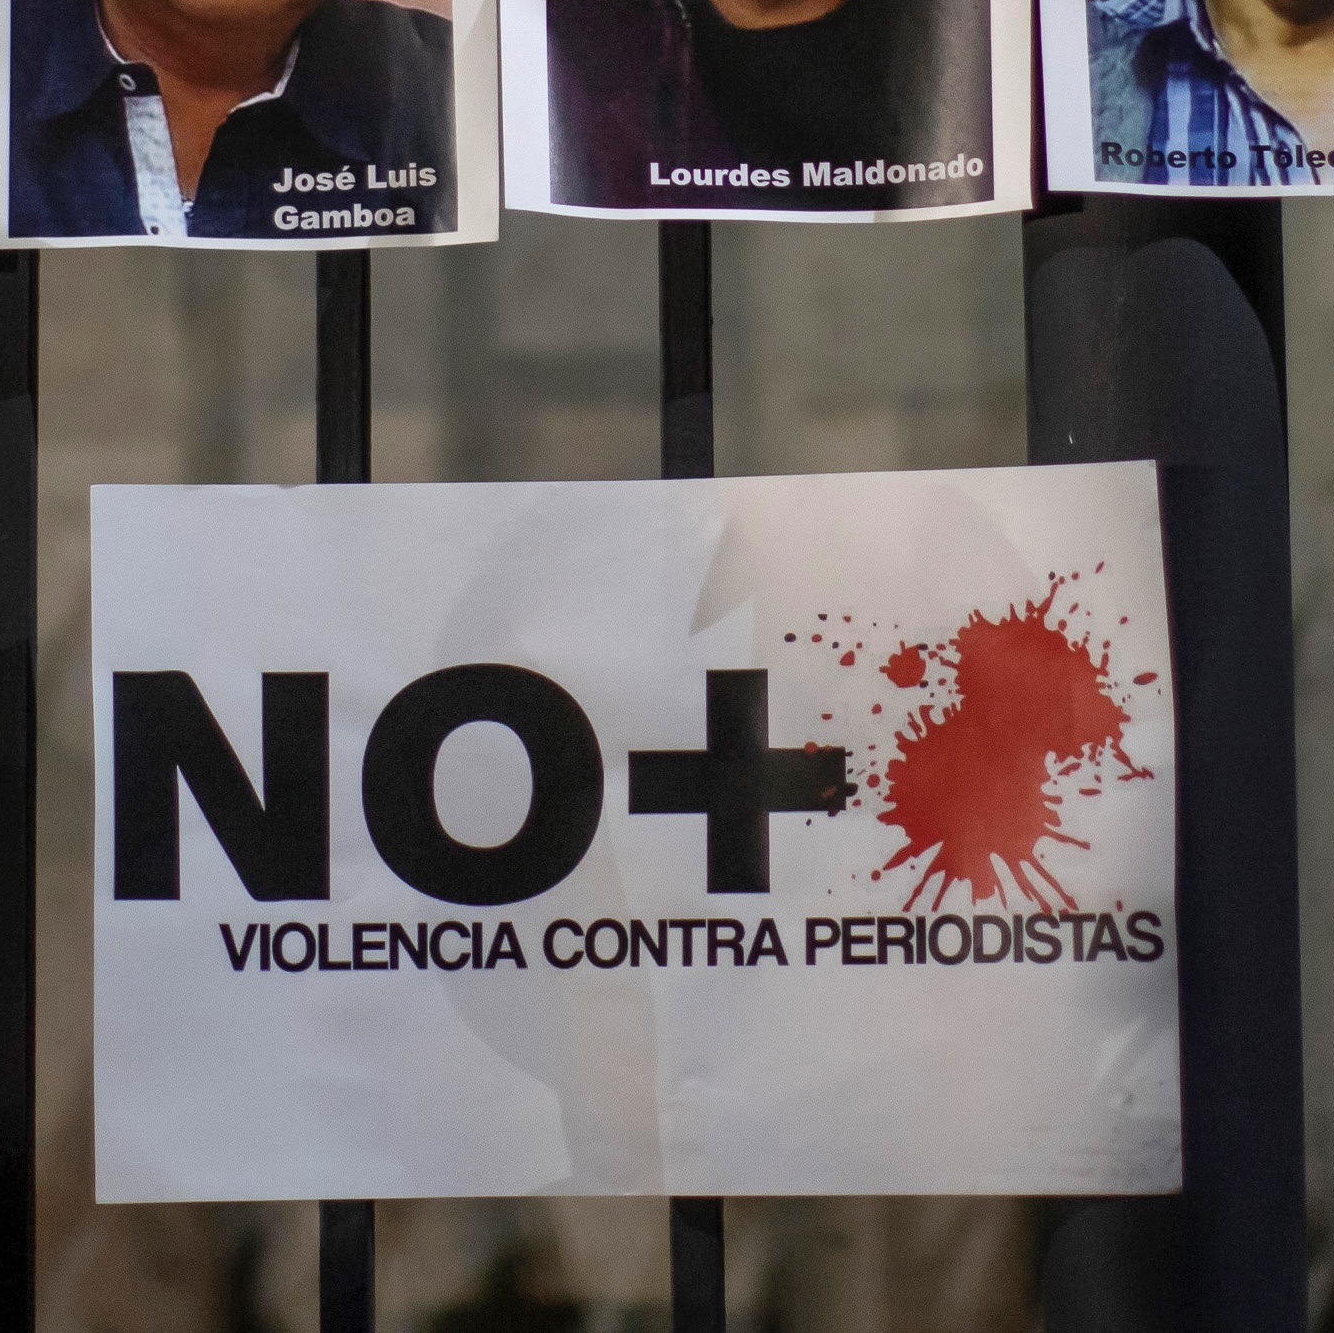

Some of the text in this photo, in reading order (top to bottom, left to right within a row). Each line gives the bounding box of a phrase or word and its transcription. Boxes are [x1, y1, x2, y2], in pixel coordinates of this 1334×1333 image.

[649, 153, 985, 188] Lourdes Maldonado
[1100, 141, 1238, 171] Roberto
[272, 162, 438, 193] José Luis
[274, 203, 417, 231] Gamboa
[218, 911, 1166, 973] VIOLENCIA CONTRA PERIODISTAS
